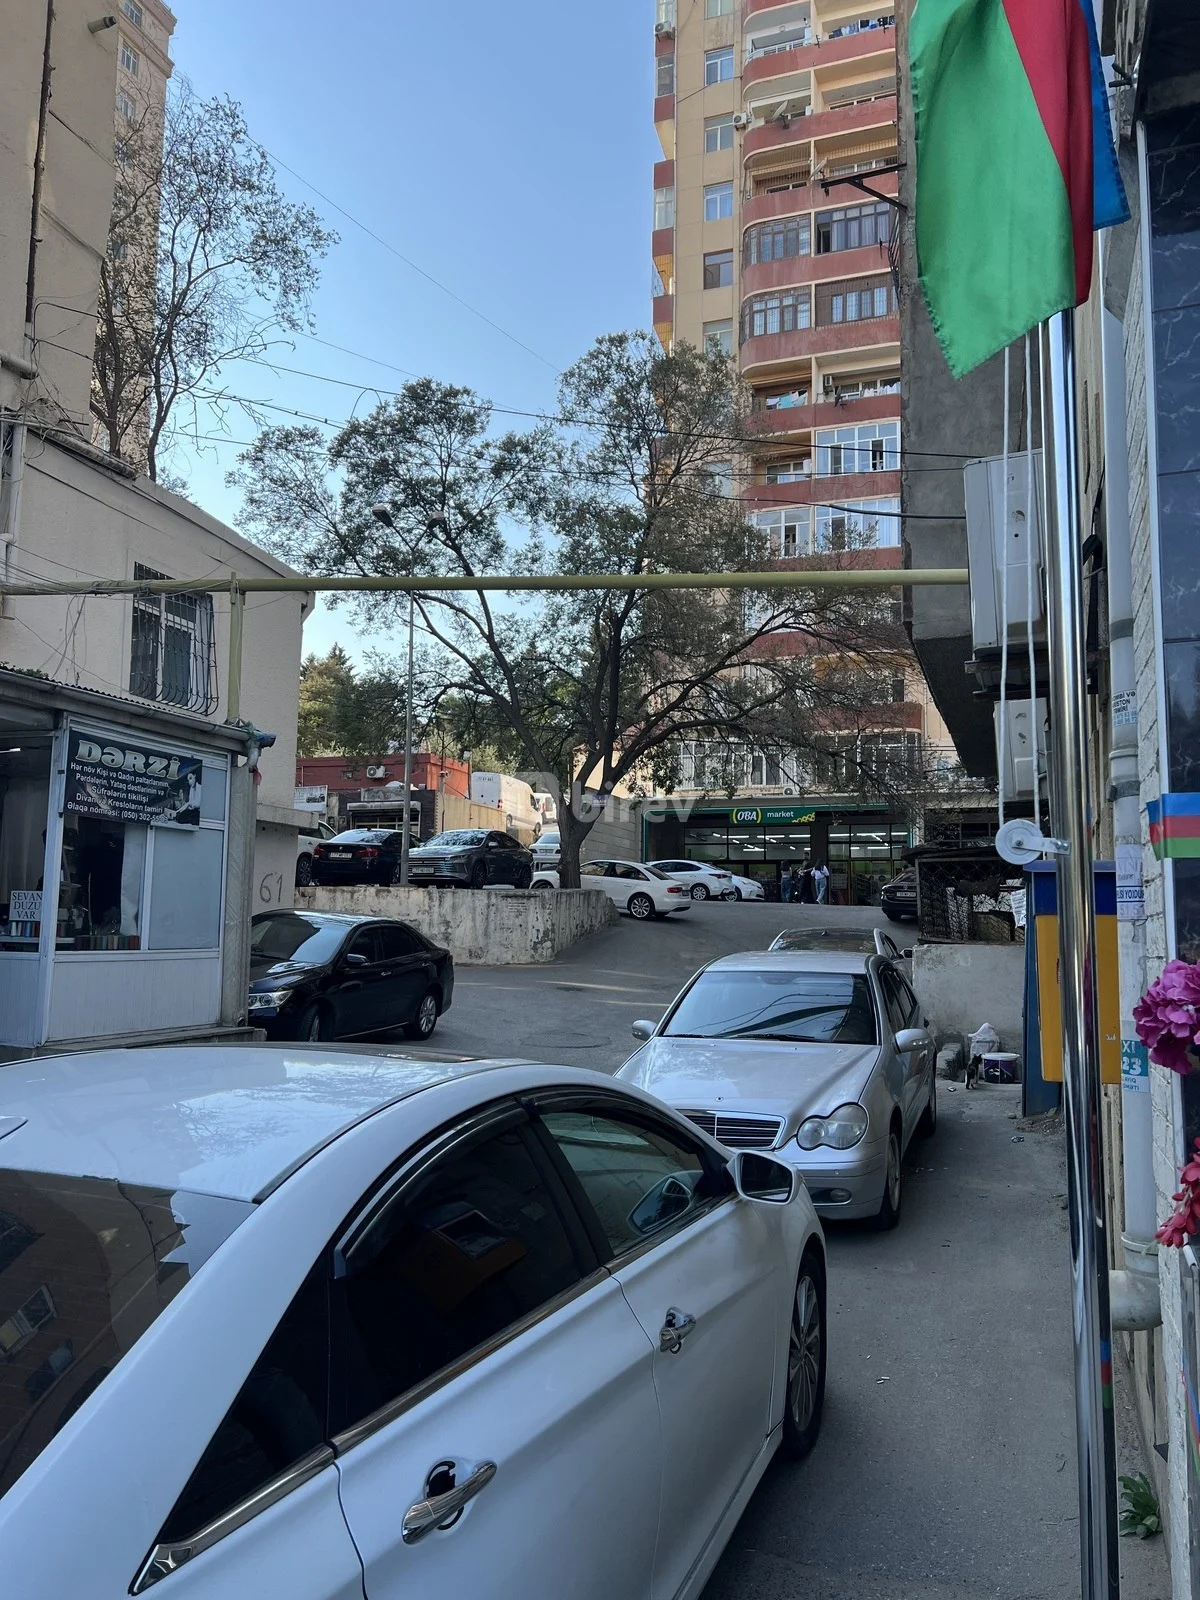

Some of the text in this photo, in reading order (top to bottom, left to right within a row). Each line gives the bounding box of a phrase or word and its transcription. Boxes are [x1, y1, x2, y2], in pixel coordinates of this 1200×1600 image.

[70, 762, 82, 771] Hər
[83, 766, 96, 774] növ
[96, 767, 109, 778] Kişi
[117, 772, 135, 782] Qadın
[110, 780, 127, 791] Yataq
[91, 785, 149, 804] Süfrələrin tikilişi
[67, 802, 89, 813] Əlaqə
[89, 806, 120, 818] nömrəsi:
[121, 810, 138, 821] (050)
[108, 799, 144, 812] Kresloların
[144, 804, 163, 814] təmiri
[767, 810, 795, 818] market
[260, 872, 283, 903] 61
[12, 891, 43, 901] SEVAN
[13, 901, 41, 910] DUZU
[17, 910, 36, 919] VAR
